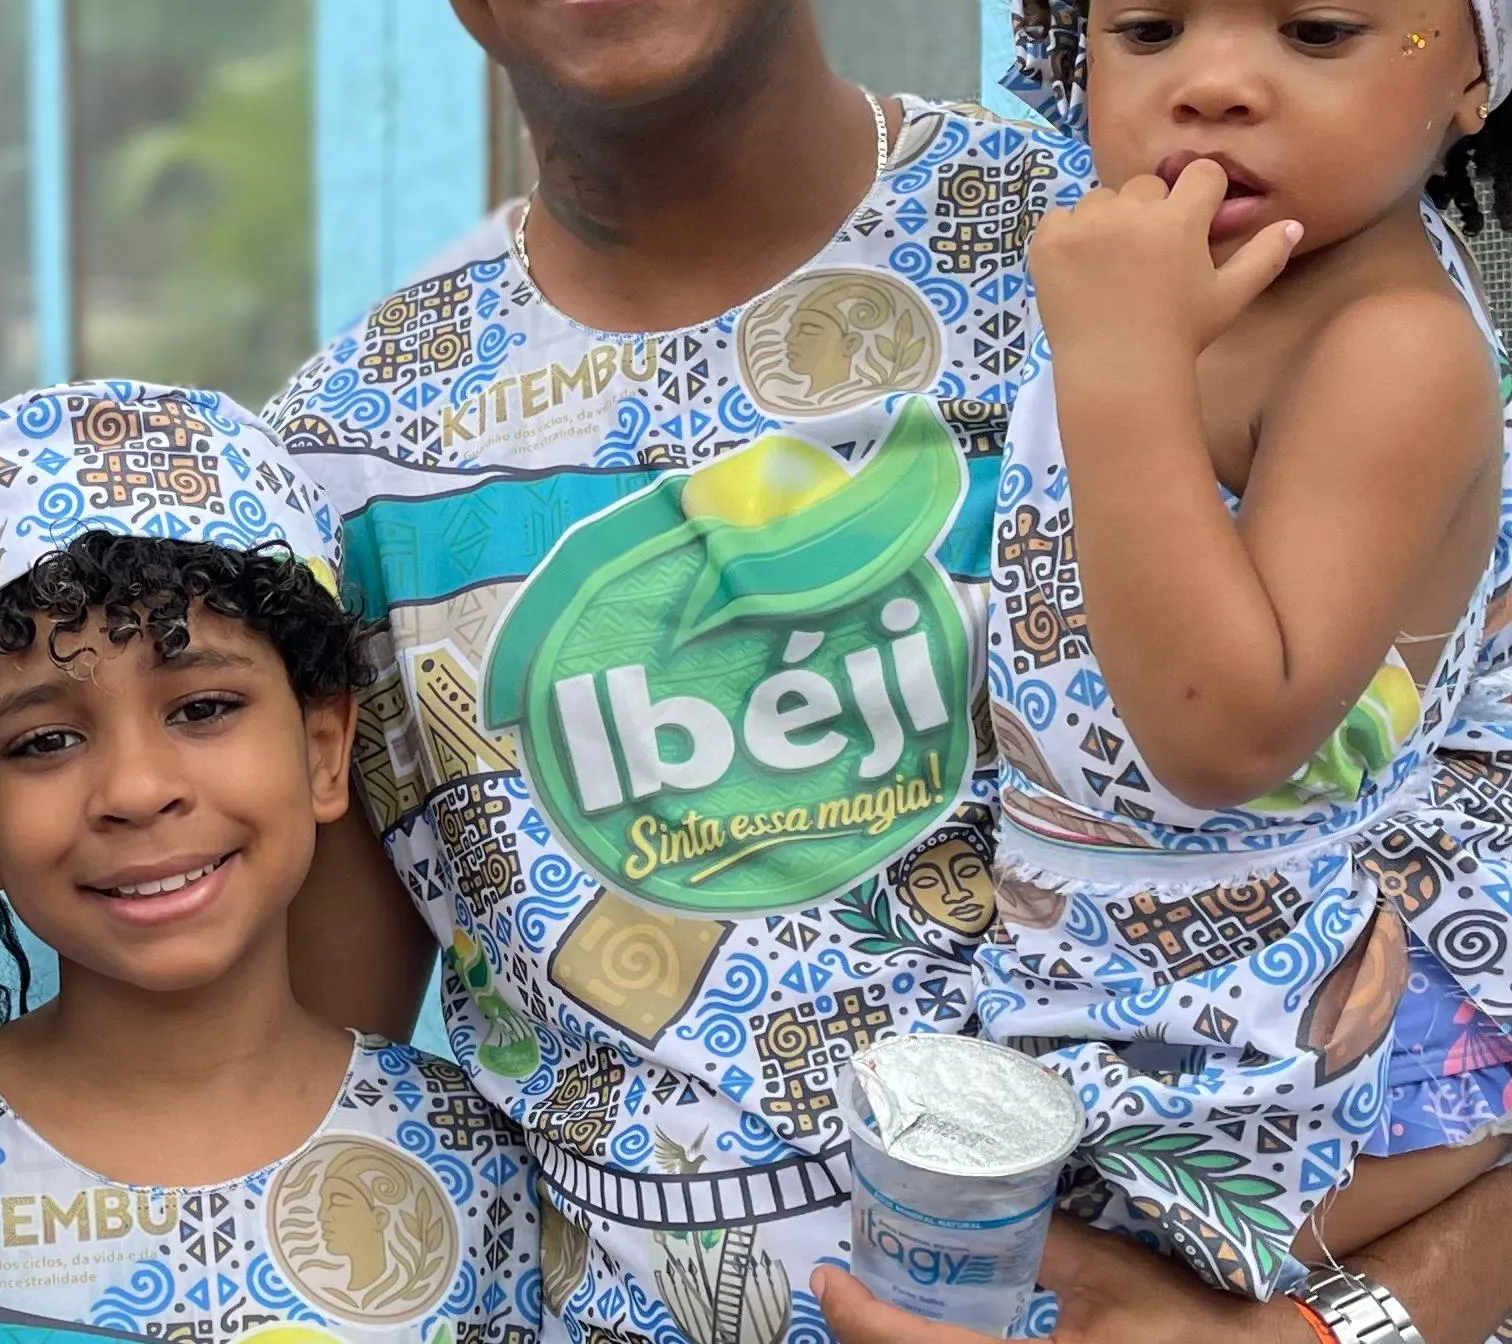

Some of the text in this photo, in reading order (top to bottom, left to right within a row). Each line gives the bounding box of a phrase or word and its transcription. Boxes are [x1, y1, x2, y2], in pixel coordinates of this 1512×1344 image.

[441, 340, 659, 447] KITEMBU
[555, 597, 949, 812] Ibéji
[625, 752, 944, 880] Sinta essa magia!
[23, 1255, 68, 1271] ciclos,
[72, 1253, 91, 1267] da
[93, 1249, 124, 1264] vida
[140, 1247, 158, 1261] da
